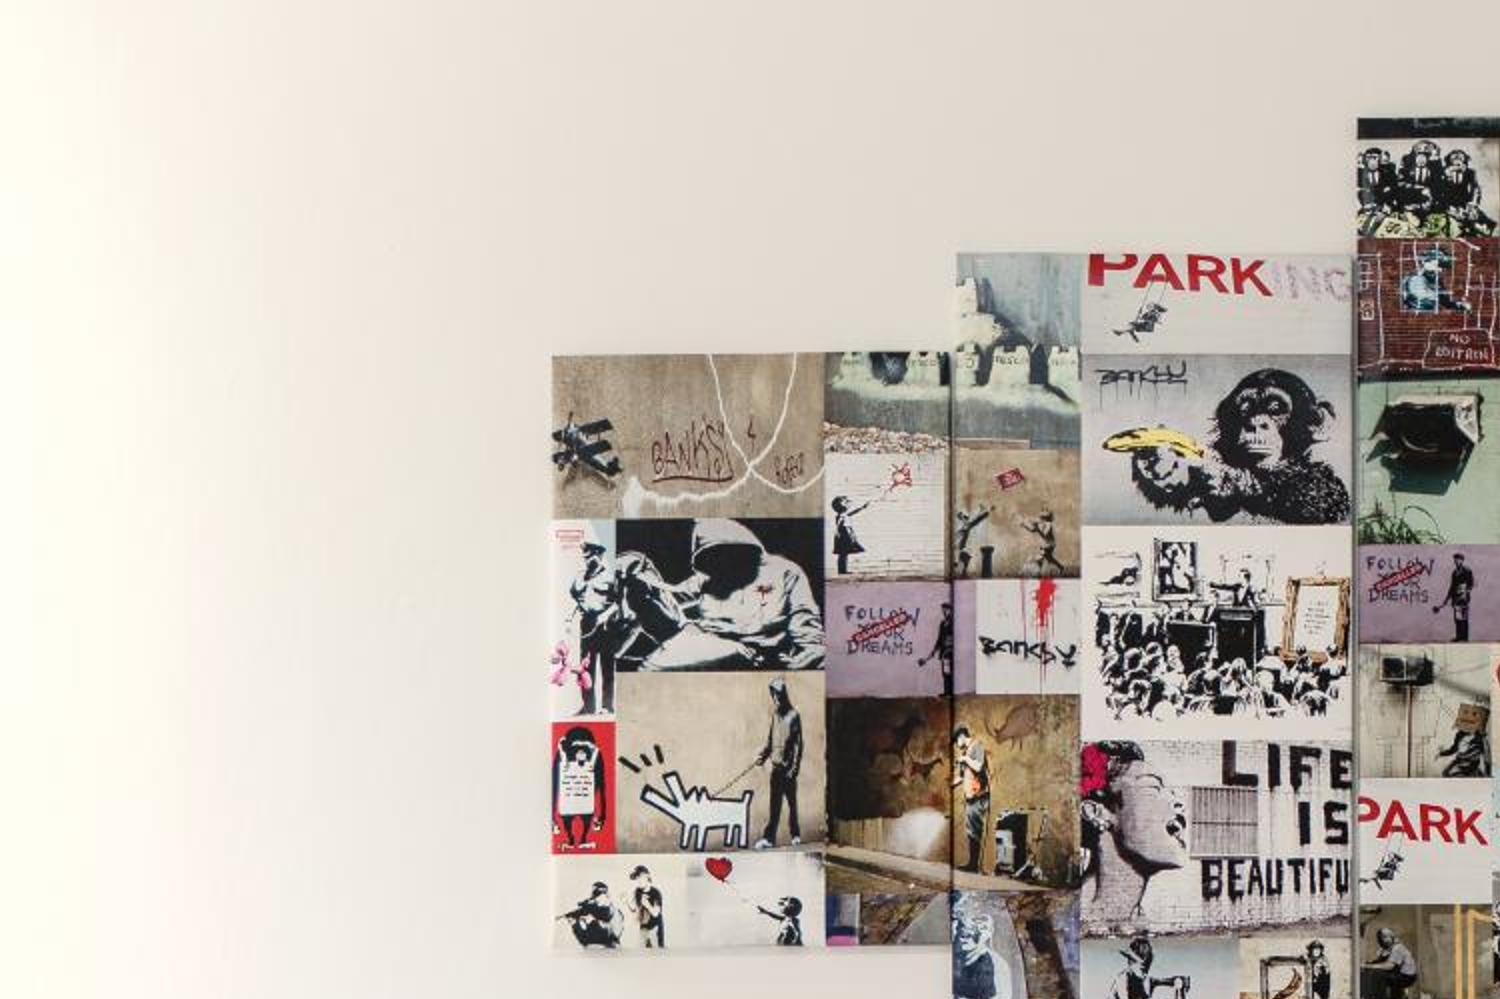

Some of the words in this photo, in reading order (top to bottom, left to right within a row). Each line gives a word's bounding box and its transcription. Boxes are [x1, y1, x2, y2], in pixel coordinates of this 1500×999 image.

[847, 639, 914, 655] DREAMS
[1222, 739, 1352, 793] LIFE
[1297, 801, 1349, 845] IS
[1357, 796, 1488, 846] PARK
